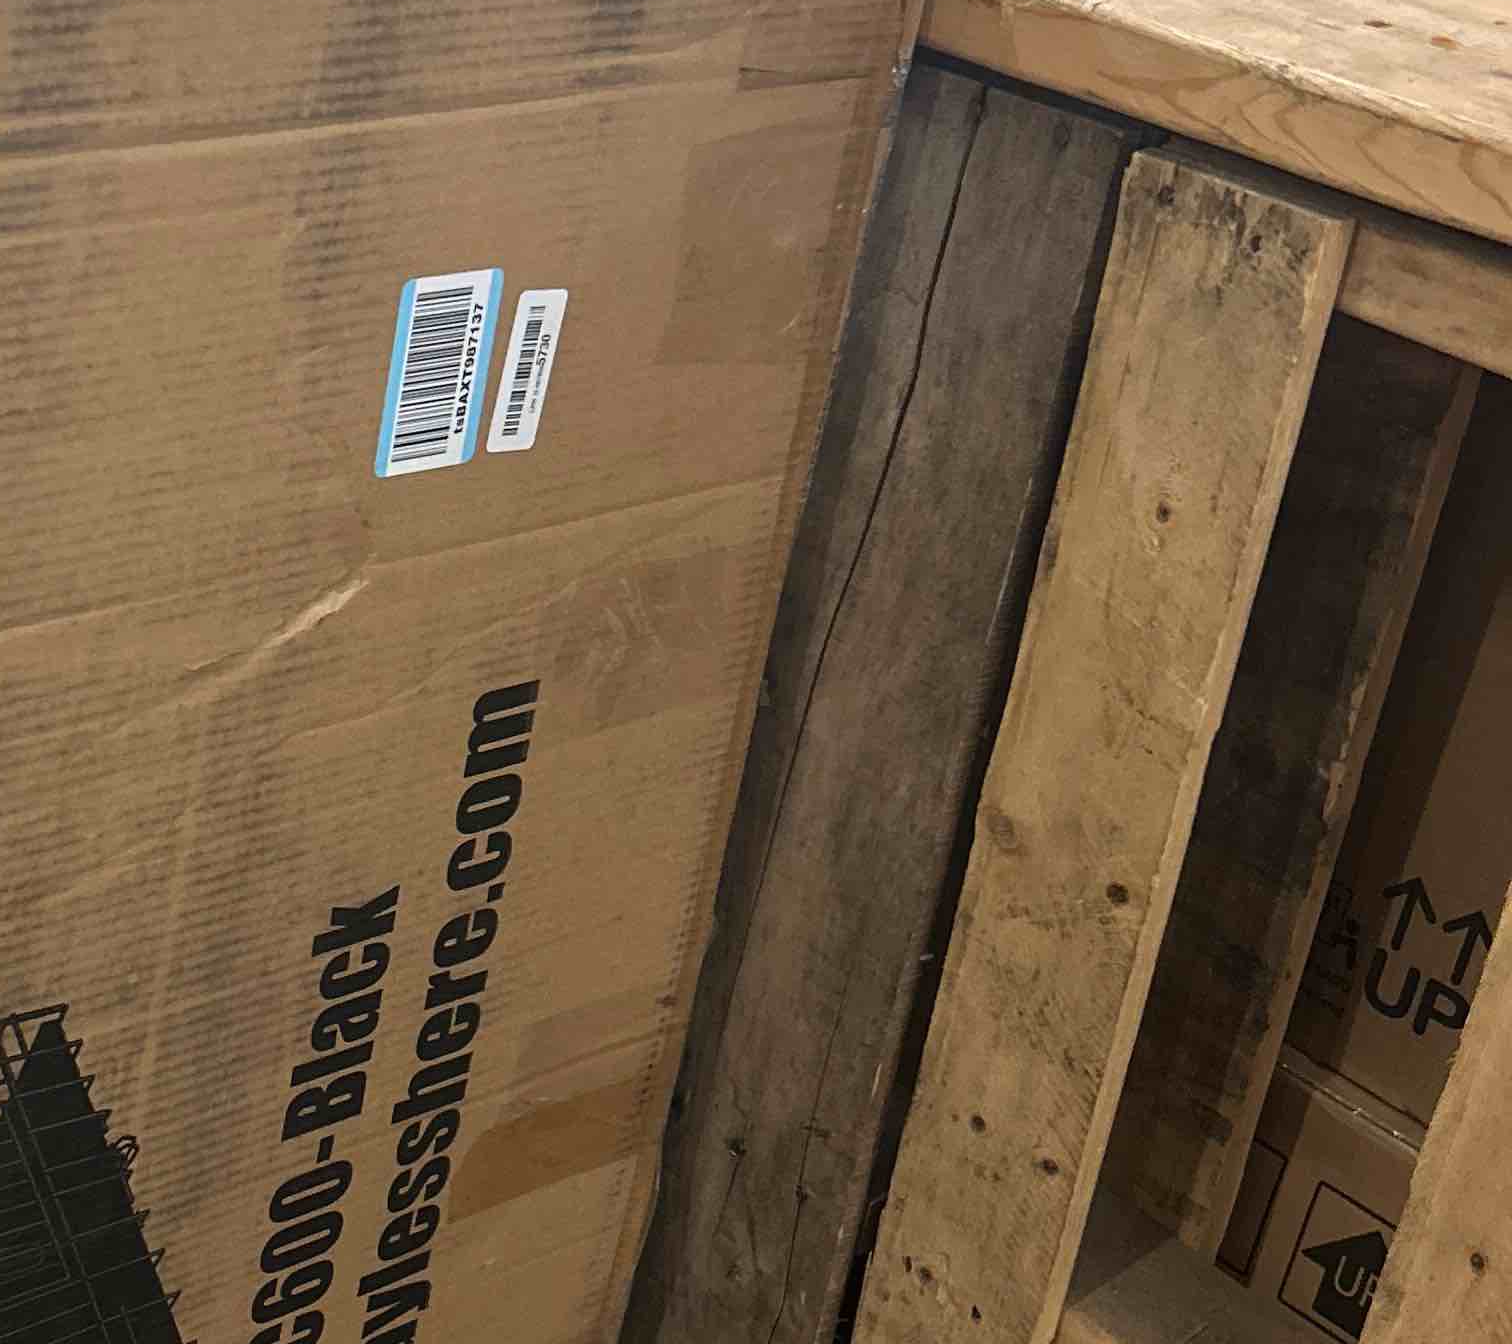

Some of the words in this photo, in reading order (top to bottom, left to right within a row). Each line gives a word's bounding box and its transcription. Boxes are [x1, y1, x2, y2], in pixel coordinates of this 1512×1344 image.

[453, 303, 484, 434] tsBAXT987137
[535, 334, 552, 368] 5730
[1364, 947, 1471, 1035] UP
